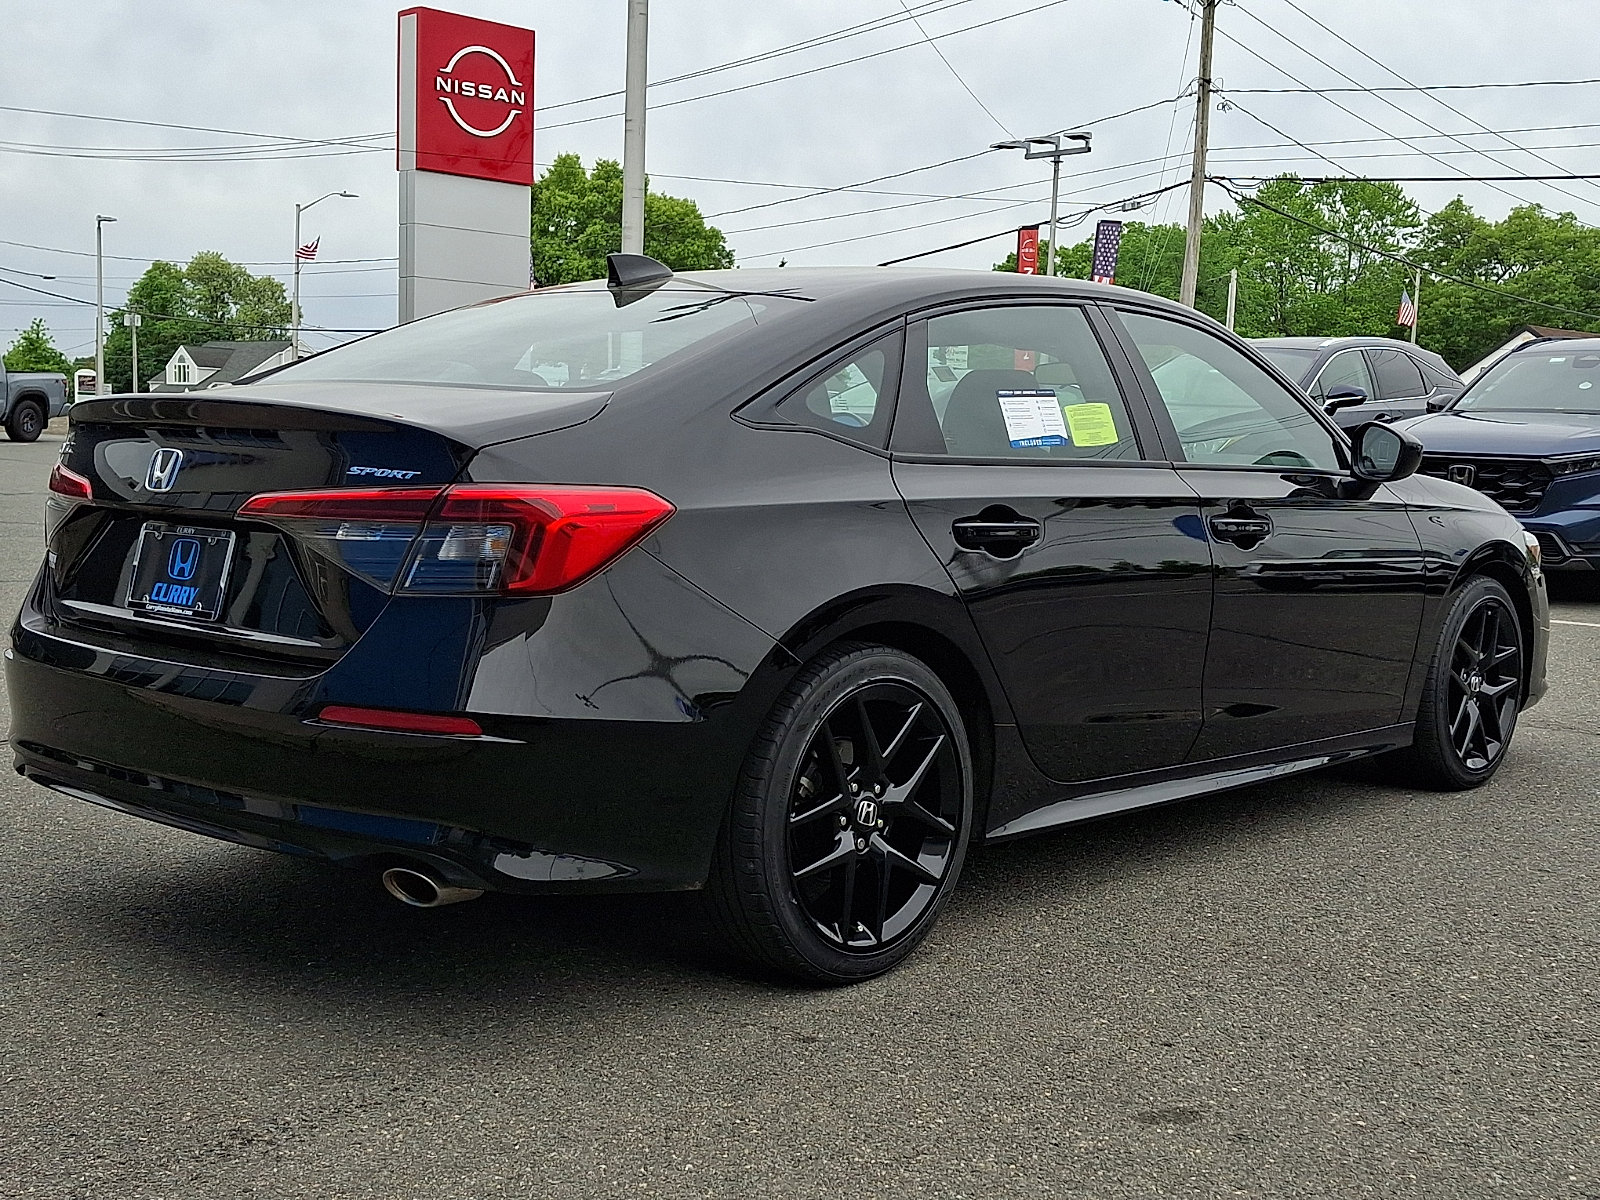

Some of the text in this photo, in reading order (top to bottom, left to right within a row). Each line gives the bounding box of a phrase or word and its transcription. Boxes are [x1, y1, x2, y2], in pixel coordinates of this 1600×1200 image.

[436, 76, 525, 106] NISSAN
[346, 466, 422, 479] SPORT
[151, 582, 200, 606] CURRY
